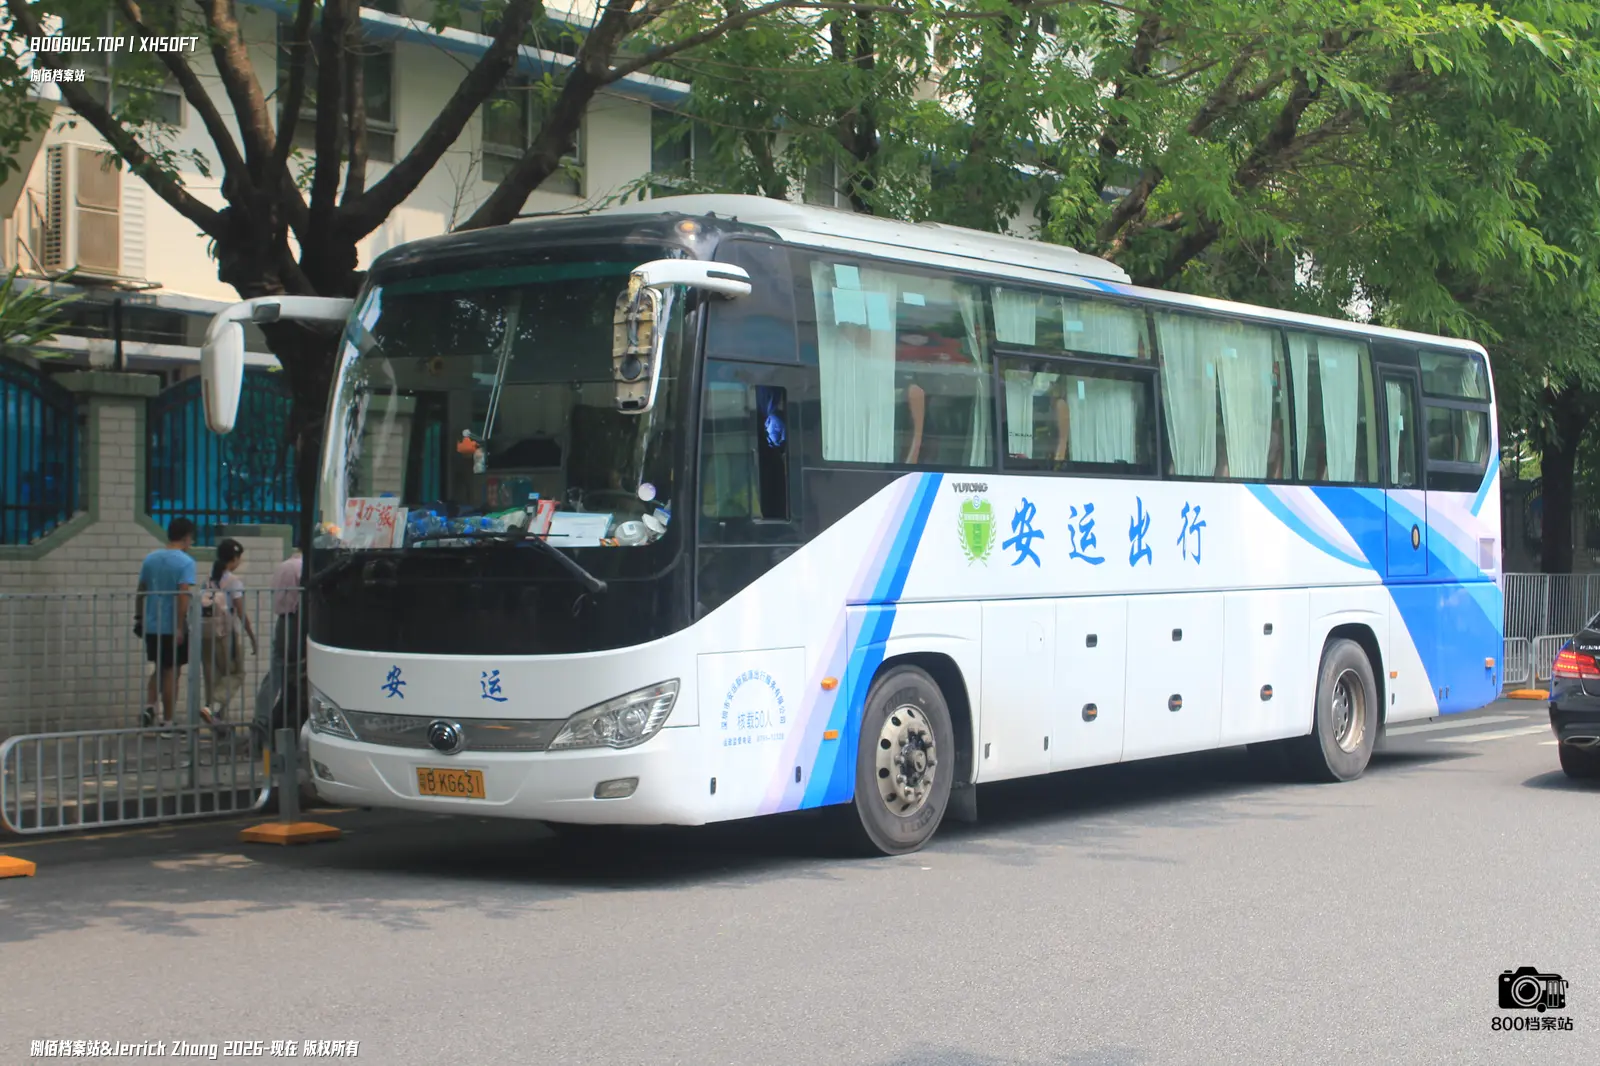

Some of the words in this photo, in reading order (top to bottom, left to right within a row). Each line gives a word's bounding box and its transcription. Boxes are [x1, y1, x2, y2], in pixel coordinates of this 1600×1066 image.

[952, 482, 988, 493] YUTONG
[1002, 496, 1207, 568] 安运出行
